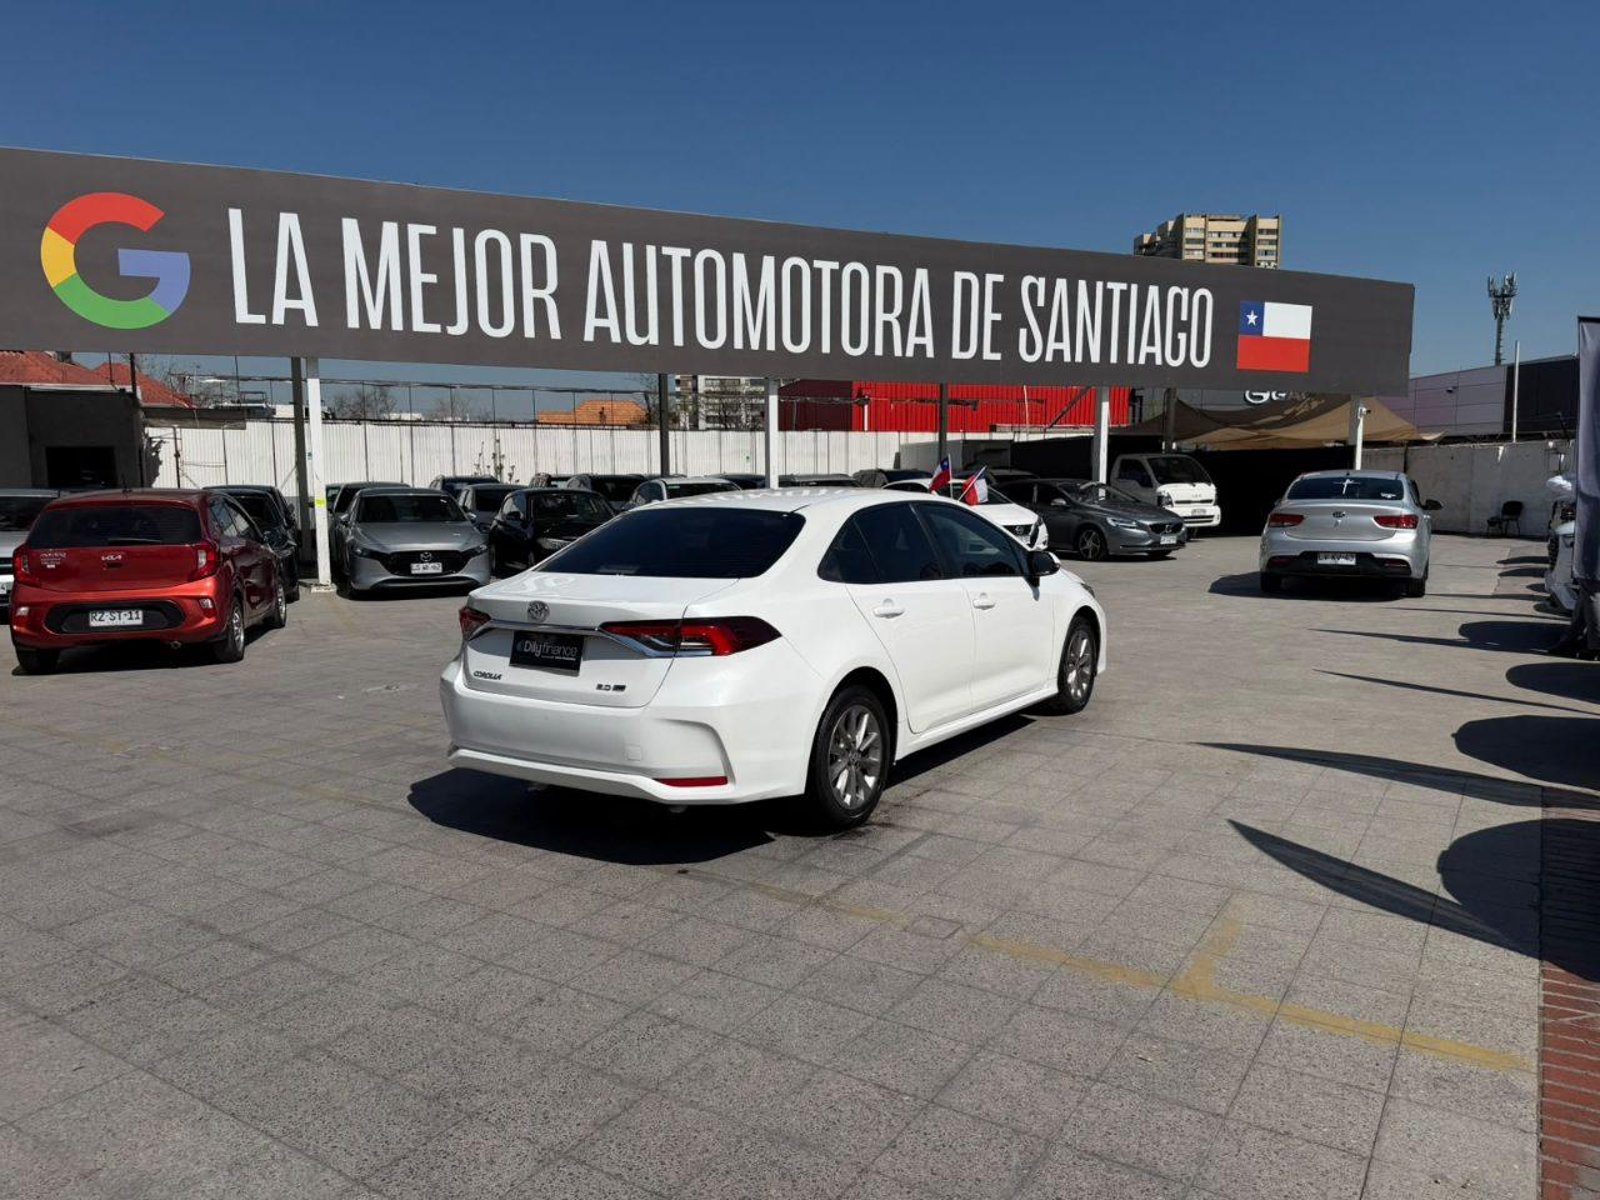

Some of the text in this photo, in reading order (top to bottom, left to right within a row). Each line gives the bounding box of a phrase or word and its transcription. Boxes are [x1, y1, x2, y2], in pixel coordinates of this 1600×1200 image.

[228, 208, 319, 327] LA
[341, 217, 562, 340] MEJOR
[583, 239, 935, 358] AUTOMOTORA
[951, 271, 1005, 361] DE
[1018, 275, 1213, 368] SANTIAGO
[473, 670, 502, 680] COROLLA
